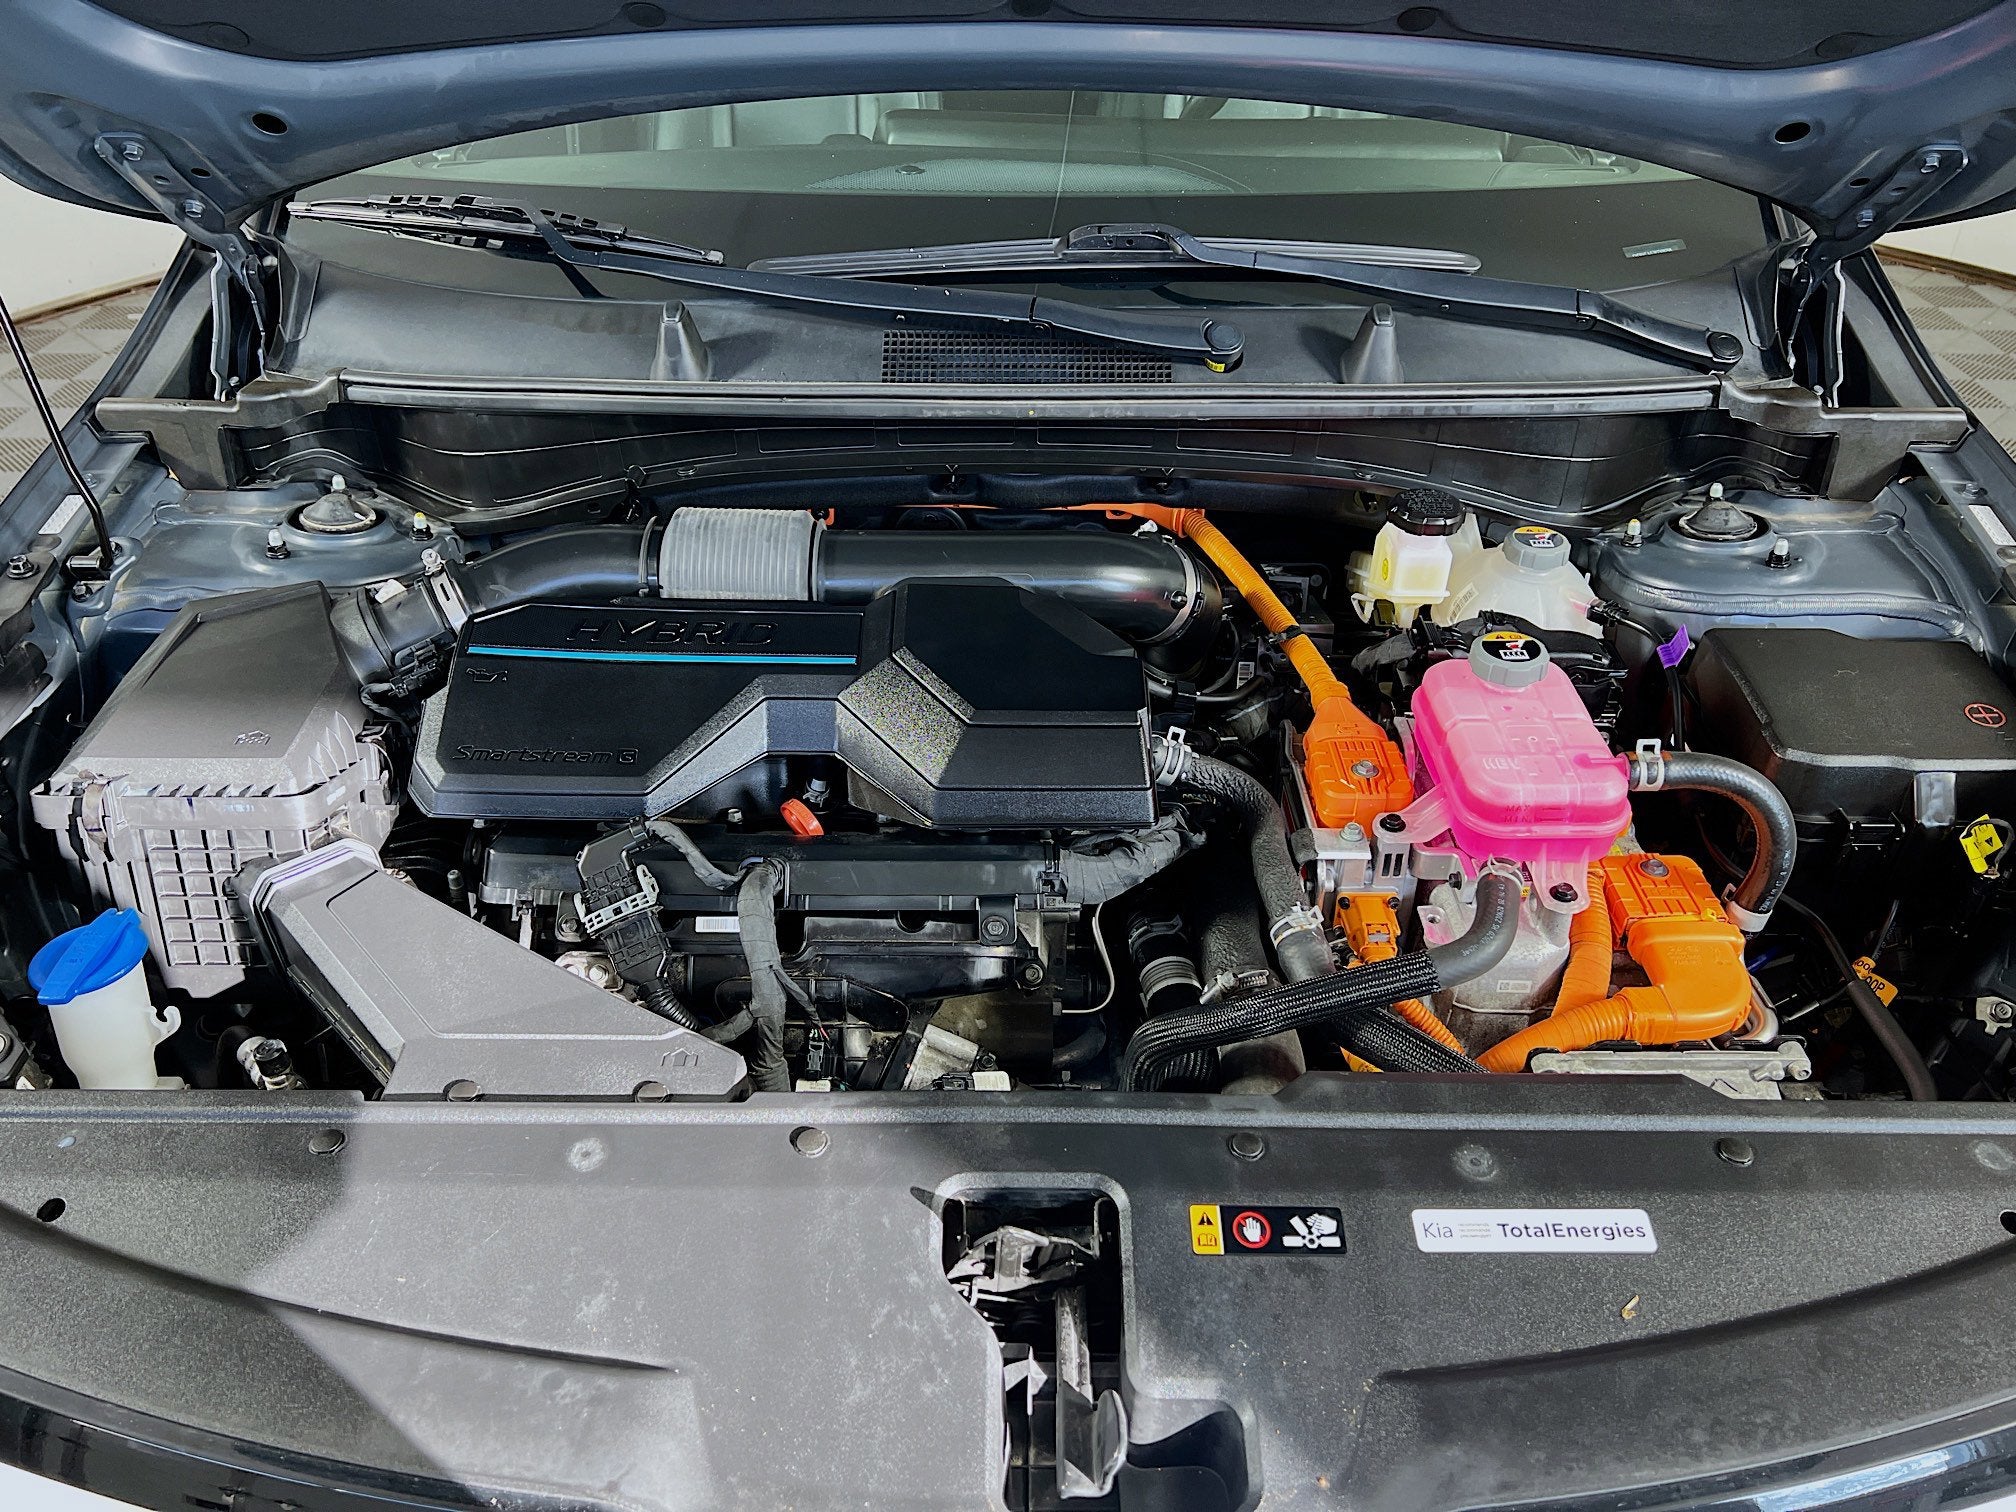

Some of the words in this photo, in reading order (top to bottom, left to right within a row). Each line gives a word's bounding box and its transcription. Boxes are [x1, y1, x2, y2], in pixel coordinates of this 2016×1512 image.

[566, 618, 779, 645] HYBRID
[452, 744, 613, 763] Smartstream
[1422, 1222, 1454, 1238] Kia
[1496, 1222, 1647, 1241] TotalEnergies
